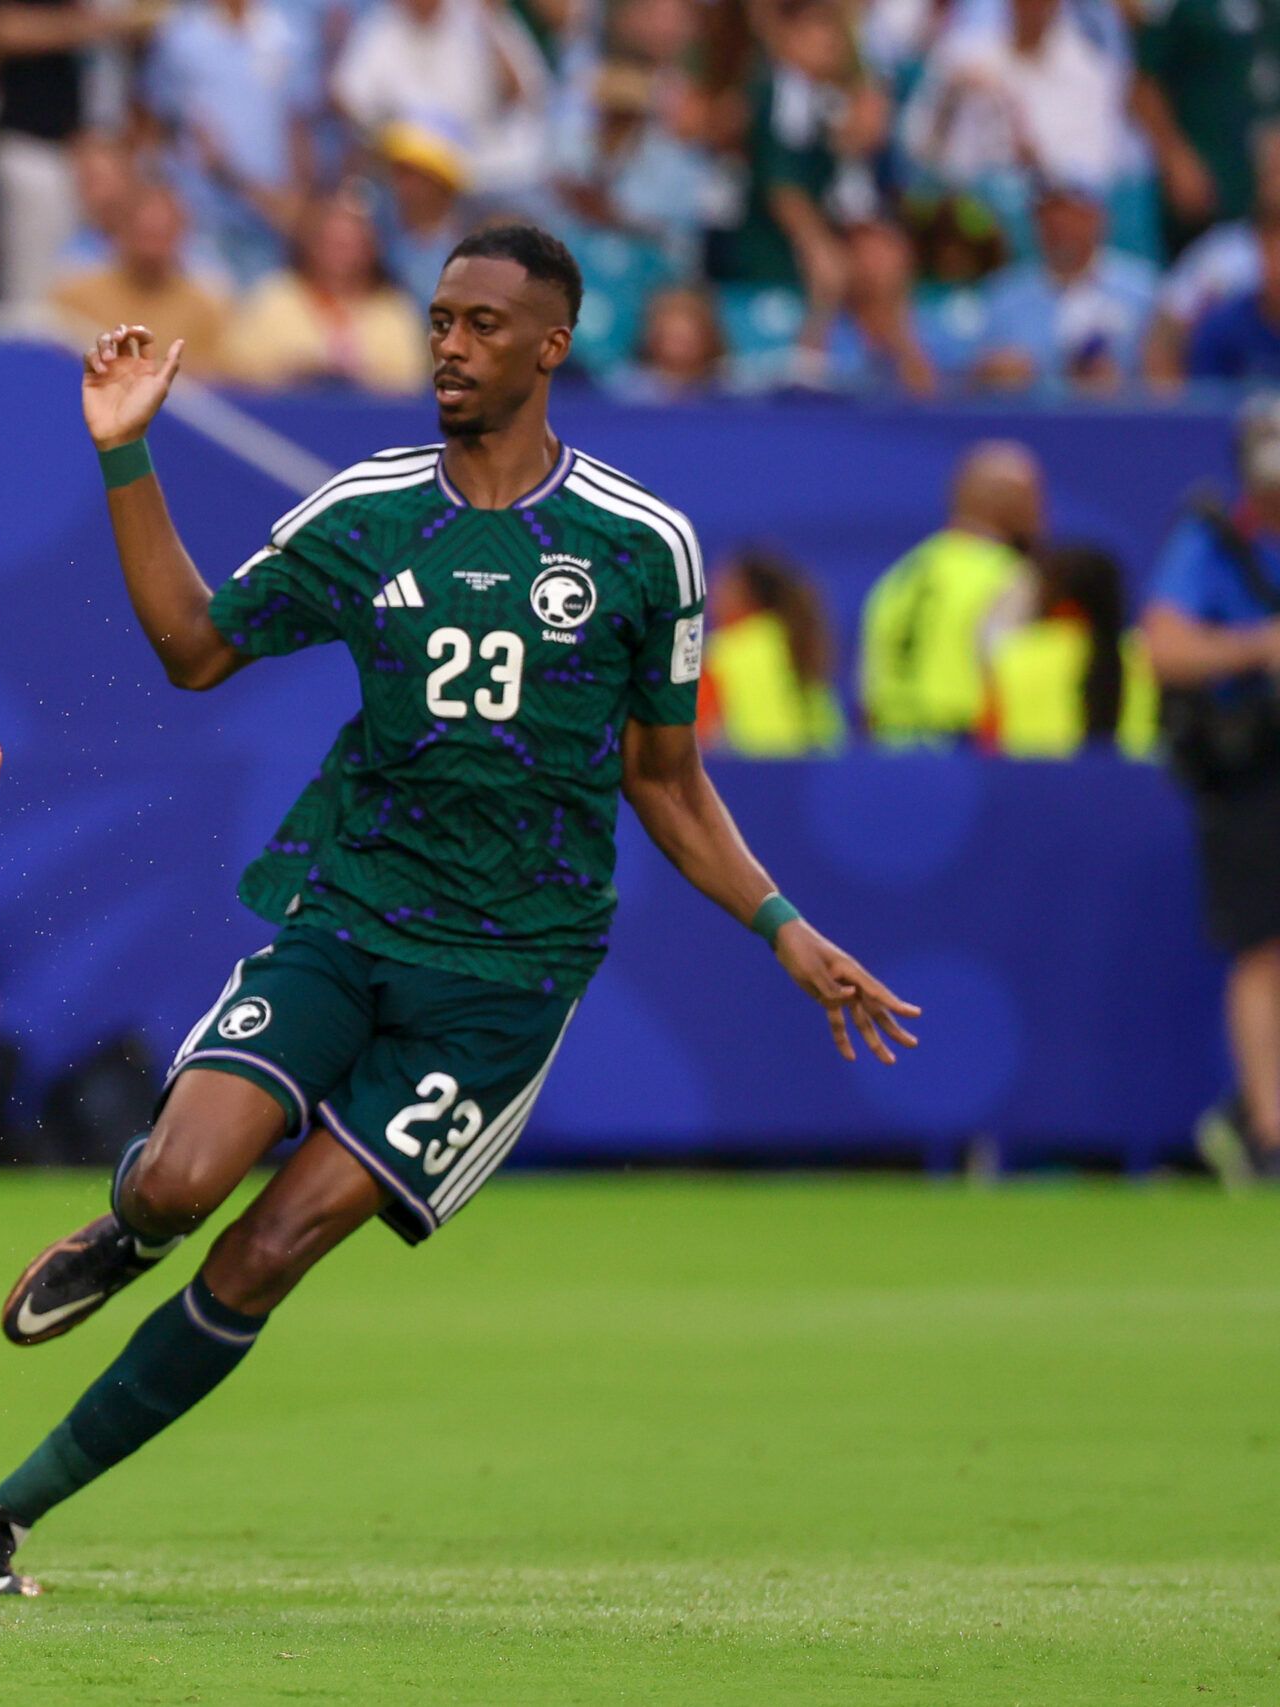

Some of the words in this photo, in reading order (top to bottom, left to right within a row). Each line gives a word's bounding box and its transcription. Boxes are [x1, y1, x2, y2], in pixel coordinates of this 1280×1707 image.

[426, 626, 525, 721] 23
[542, 629, 577, 645] SAUDI
[385, 1072, 483, 1175] 23
